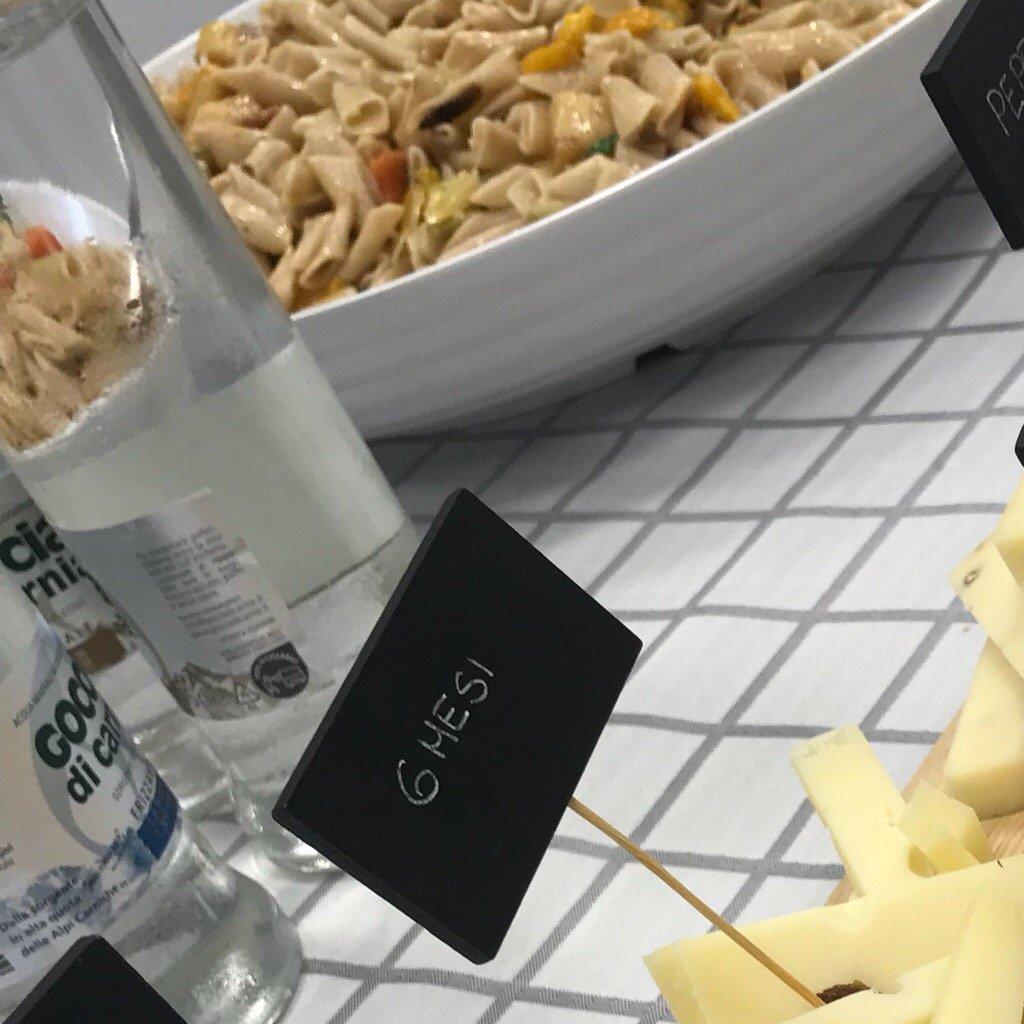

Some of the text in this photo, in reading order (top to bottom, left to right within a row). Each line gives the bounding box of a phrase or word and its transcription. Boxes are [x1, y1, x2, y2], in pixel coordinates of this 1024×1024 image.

[67, 754, 101, 804] di
[396, 657, 495, 807] 6 MESI
